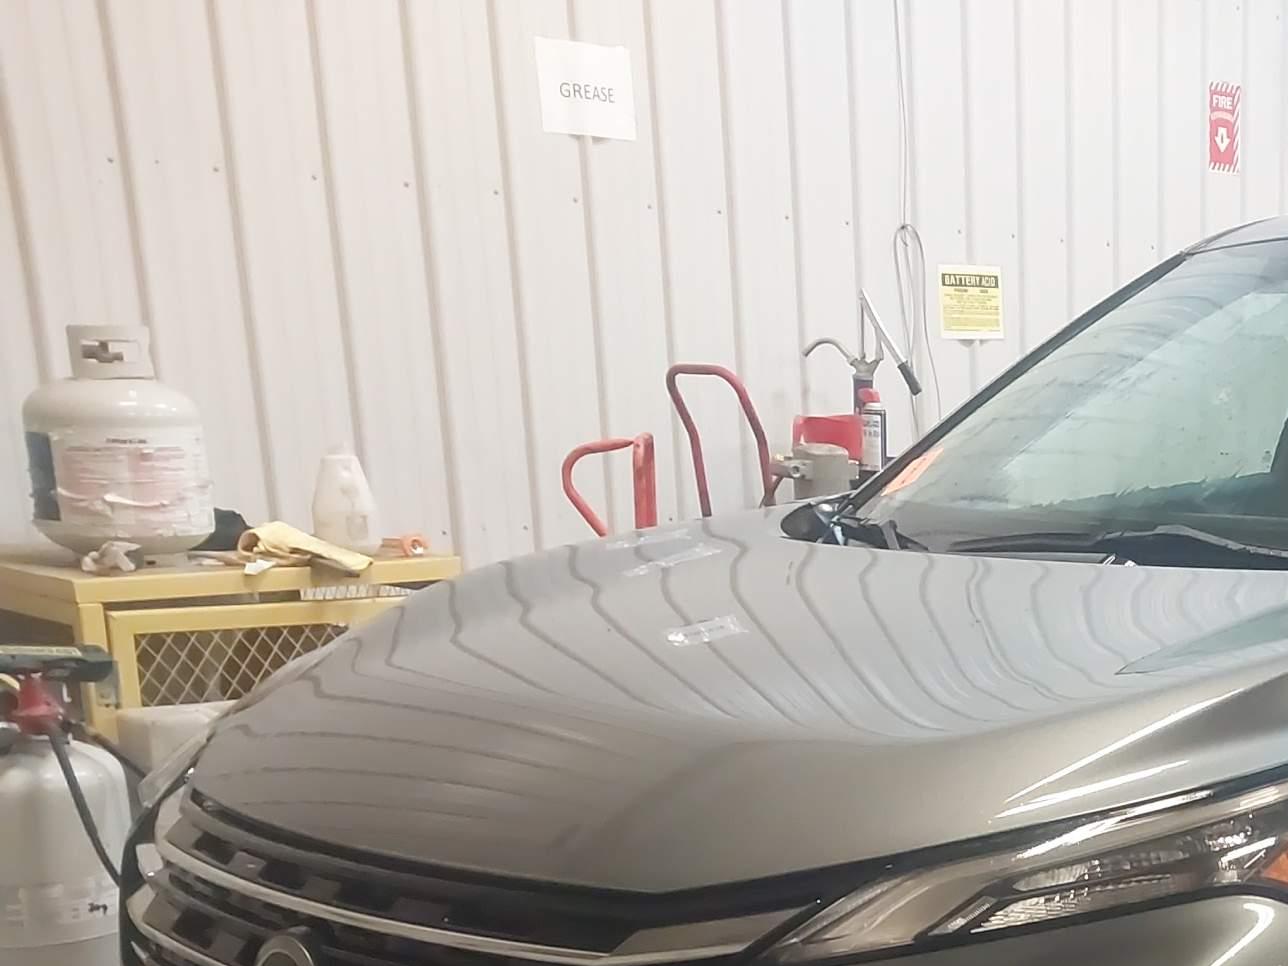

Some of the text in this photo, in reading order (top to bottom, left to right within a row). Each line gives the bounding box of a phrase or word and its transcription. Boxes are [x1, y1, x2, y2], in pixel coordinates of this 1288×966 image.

[559, 82, 615, 103] GREASE
[1212, 94, 1233, 110] FIRE
[944, 274, 996, 288] BATTERY ACID
